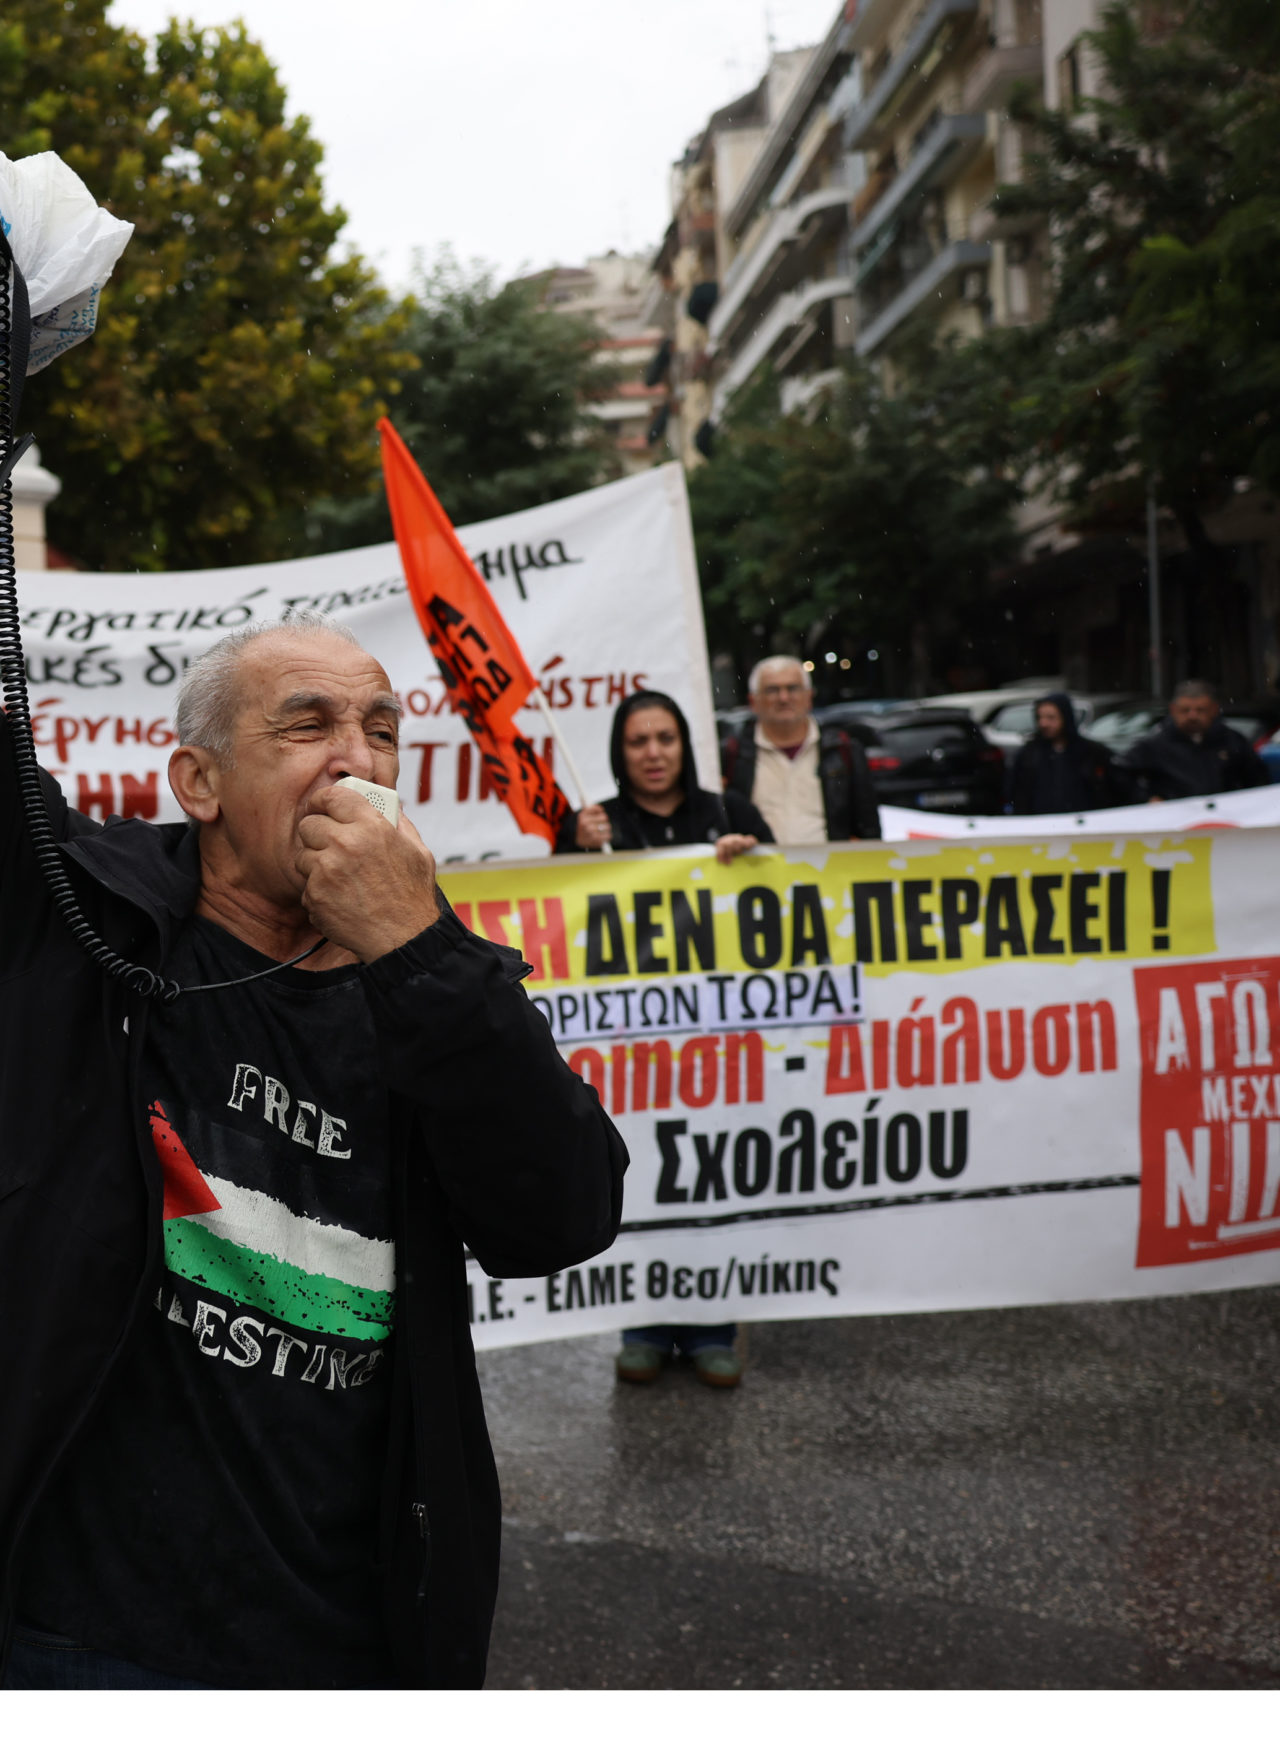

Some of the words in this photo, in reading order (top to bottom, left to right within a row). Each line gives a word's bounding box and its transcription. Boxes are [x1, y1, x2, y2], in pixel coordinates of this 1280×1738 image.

[586, 888, 716, 976] ΔΕΝ
[737, 883, 830, 969] ΘΑ
[708, 960, 861, 1021] ΤΩΡΑ!
[1154, 978, 1280, 1076] ΑΓΩ
[824, 995, 1118, 1096] Διάλυση
[227, 1063, 352, 1160] FREE
[655, 1097, 969, 1205] Σχολείου
[546, 1260, 636, 1313] ΕΛΜΕ
[154, 1287, 384, 1391] LESTINE
